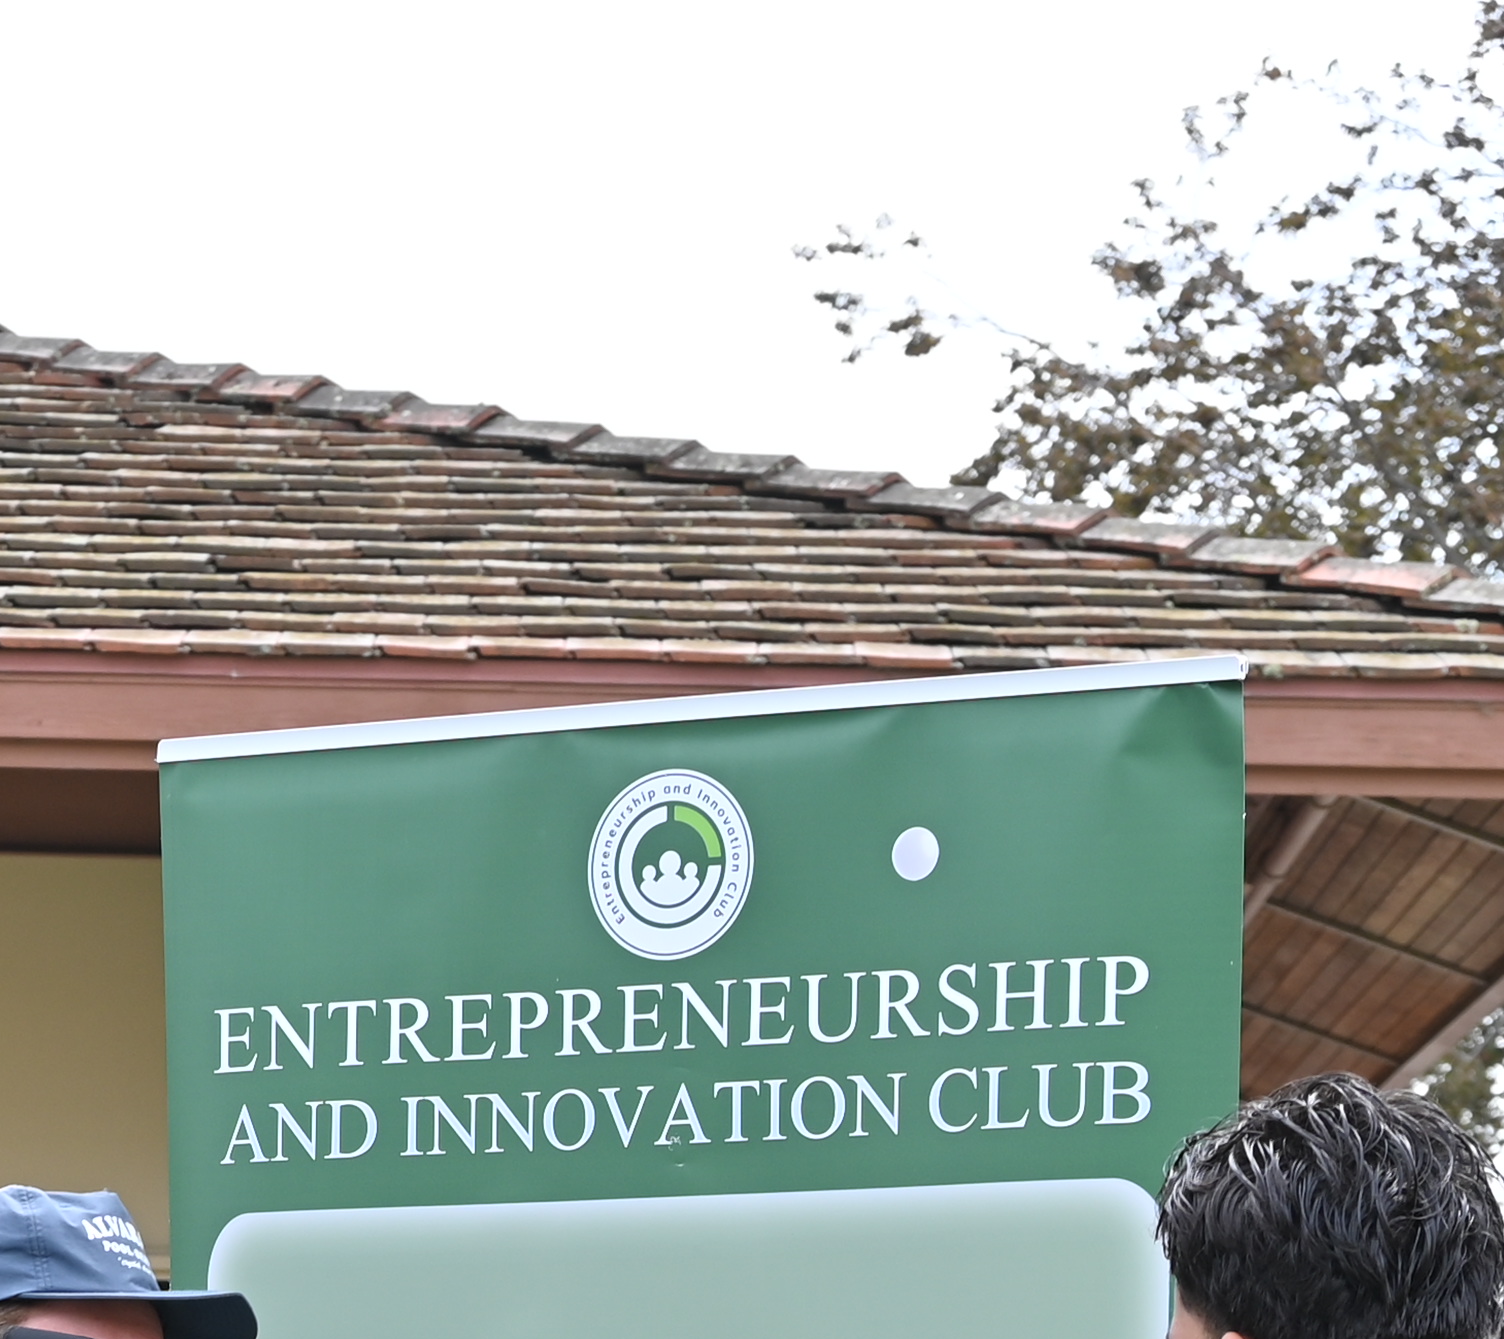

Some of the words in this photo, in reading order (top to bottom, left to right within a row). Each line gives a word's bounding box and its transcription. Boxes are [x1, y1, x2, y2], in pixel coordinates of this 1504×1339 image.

[663, 784, 692, 795] and
[697, 788, 743, 873] Innovation
[600, 788, 657, 925] Entrepreneurship
[713, 881, 738, 919] Club
[213, 955, 1150, 1074] ENTREPRENEURSHIP
[219, 1099, 378, 1165] AND
[399, 1072, 908, 1157] INNOVATION
[928, 1060, 1151, 1133] CLUB
